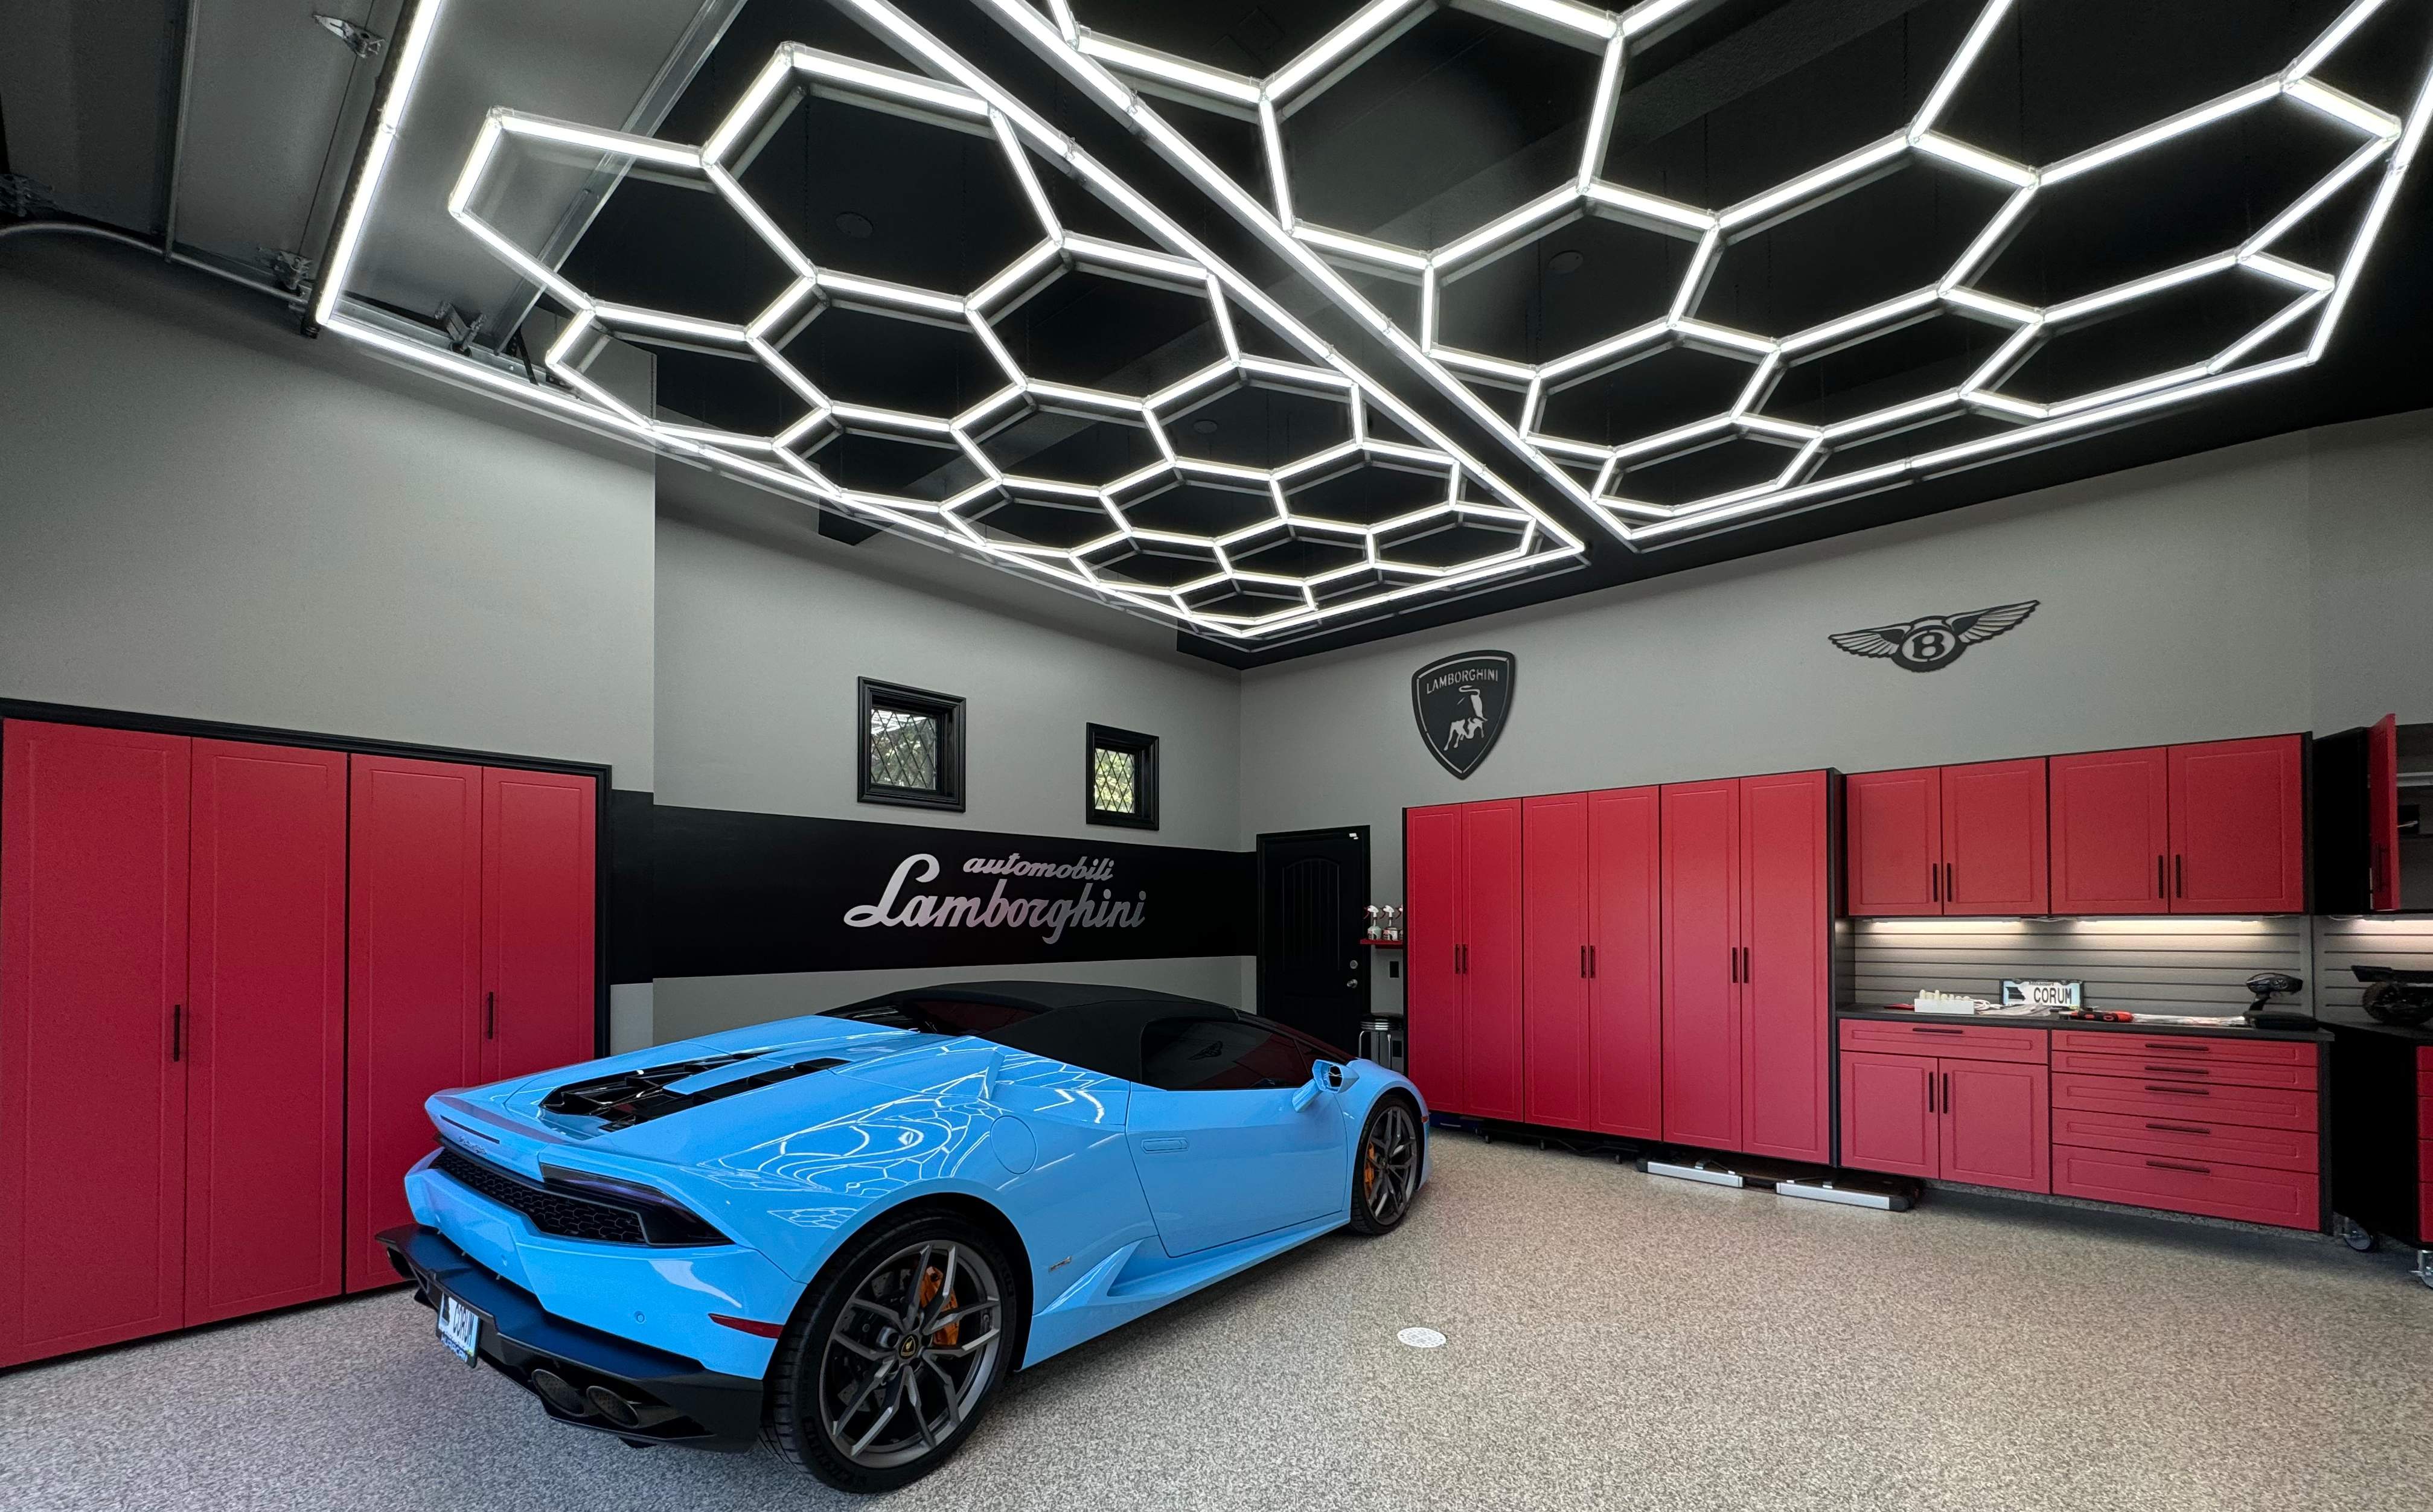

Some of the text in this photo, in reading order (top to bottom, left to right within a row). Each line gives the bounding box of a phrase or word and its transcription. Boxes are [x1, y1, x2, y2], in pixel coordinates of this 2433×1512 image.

[1912, 631, 1945, 659] B
[1426, 668, 1498, 694] LAMBORGHINI
[963, 852, 1114, 881] automobili
[843, 853, 1146, 944] Lamborghini
[2033, 987, 2072, 1004] CORUM
[453, 1303, 475, 1347] CORUM
